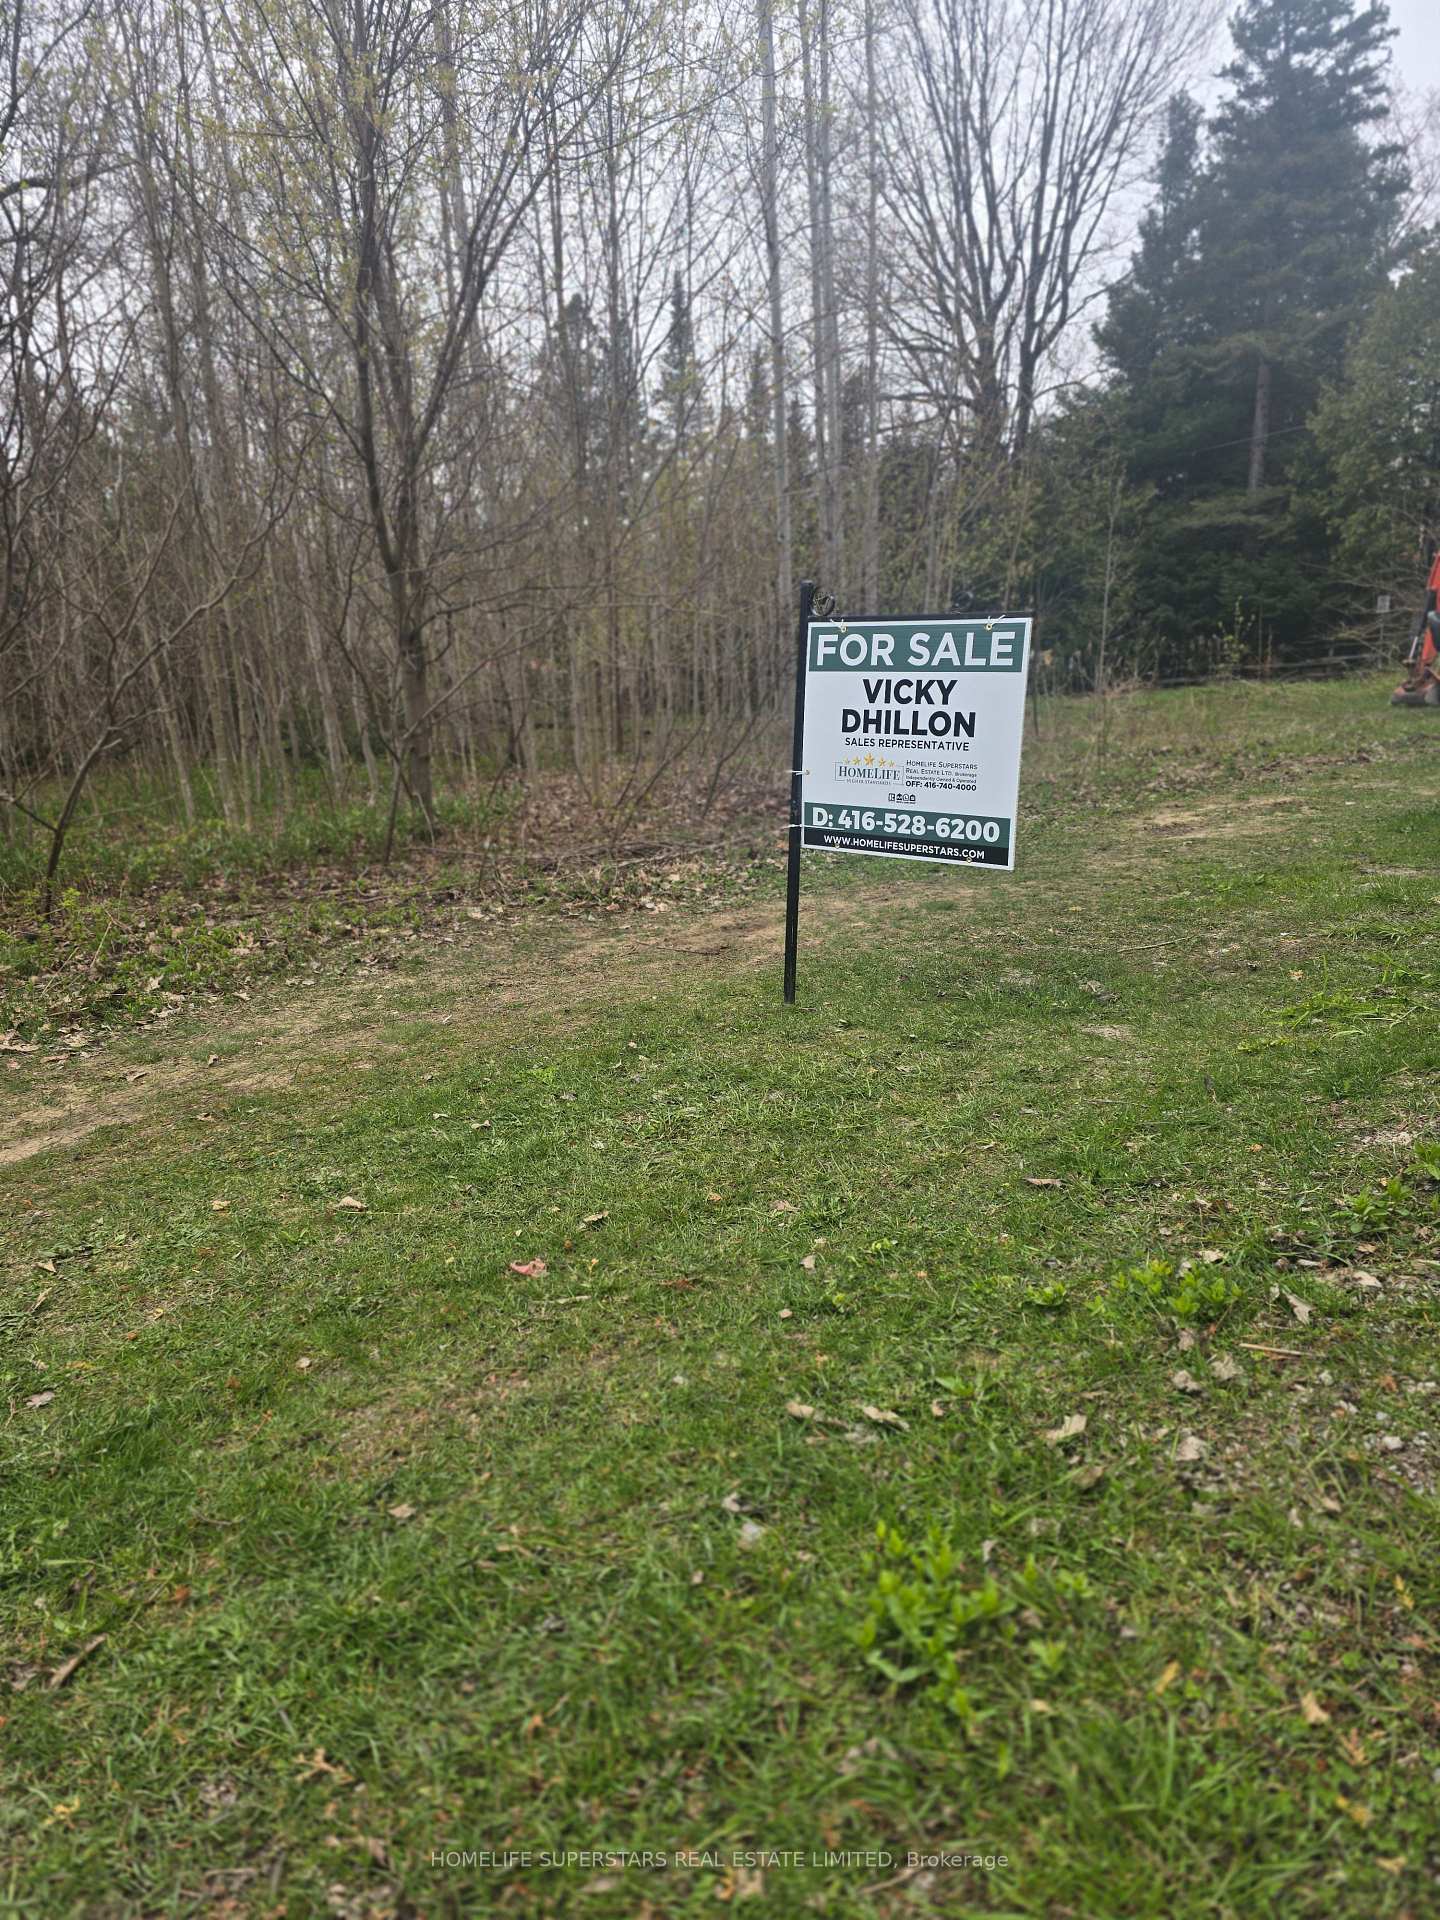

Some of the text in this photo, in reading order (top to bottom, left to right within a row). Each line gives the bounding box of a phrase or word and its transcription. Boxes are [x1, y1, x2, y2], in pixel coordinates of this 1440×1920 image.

[816, 631, 1016, 667] FOR SALE
[862, 679, 958, 705] VICKY
[841, 708, 976, 737] DHILLON
[845, 737, 970, 751] SALES REPRESENTATIVE
[905, 780, 977, 791] OFF: 416-740-4000
[811, 806, 1000, 843] D: 416-528-6200
[823, 834, 985, 860] WWW.HOMELIFESUPERSTARS.COM
